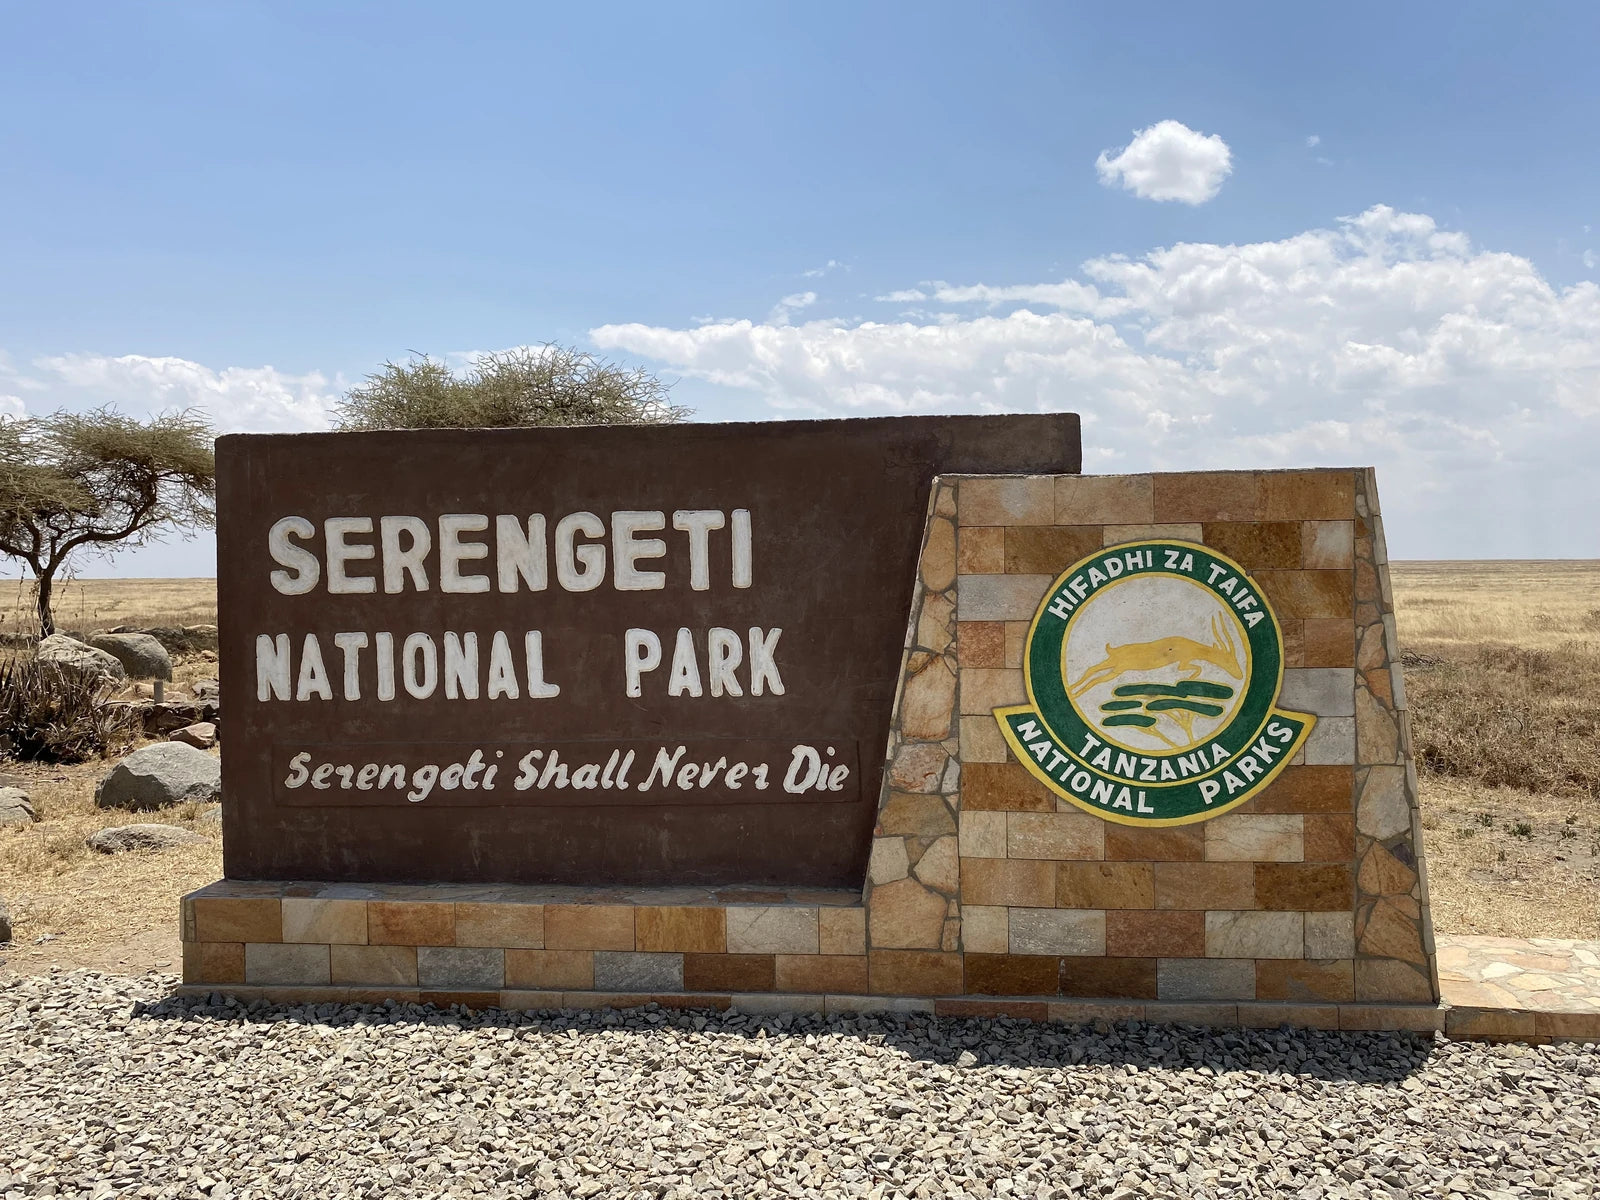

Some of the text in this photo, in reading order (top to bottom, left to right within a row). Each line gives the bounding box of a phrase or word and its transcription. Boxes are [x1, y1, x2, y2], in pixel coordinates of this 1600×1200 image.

[268, 508, 753, 595] SERENGETI
[1048, 550, 1265, 629] HIFADHI ZA TAIFA
[255, 626, 786, 702] NATIONAL PARK
[284, 744, 850, 802] Serengeti Shall Never Die
[1017, 720, 1294, 813] NATIONAL PARKS
[1079, 732, 1231, 781] TANZANIA
